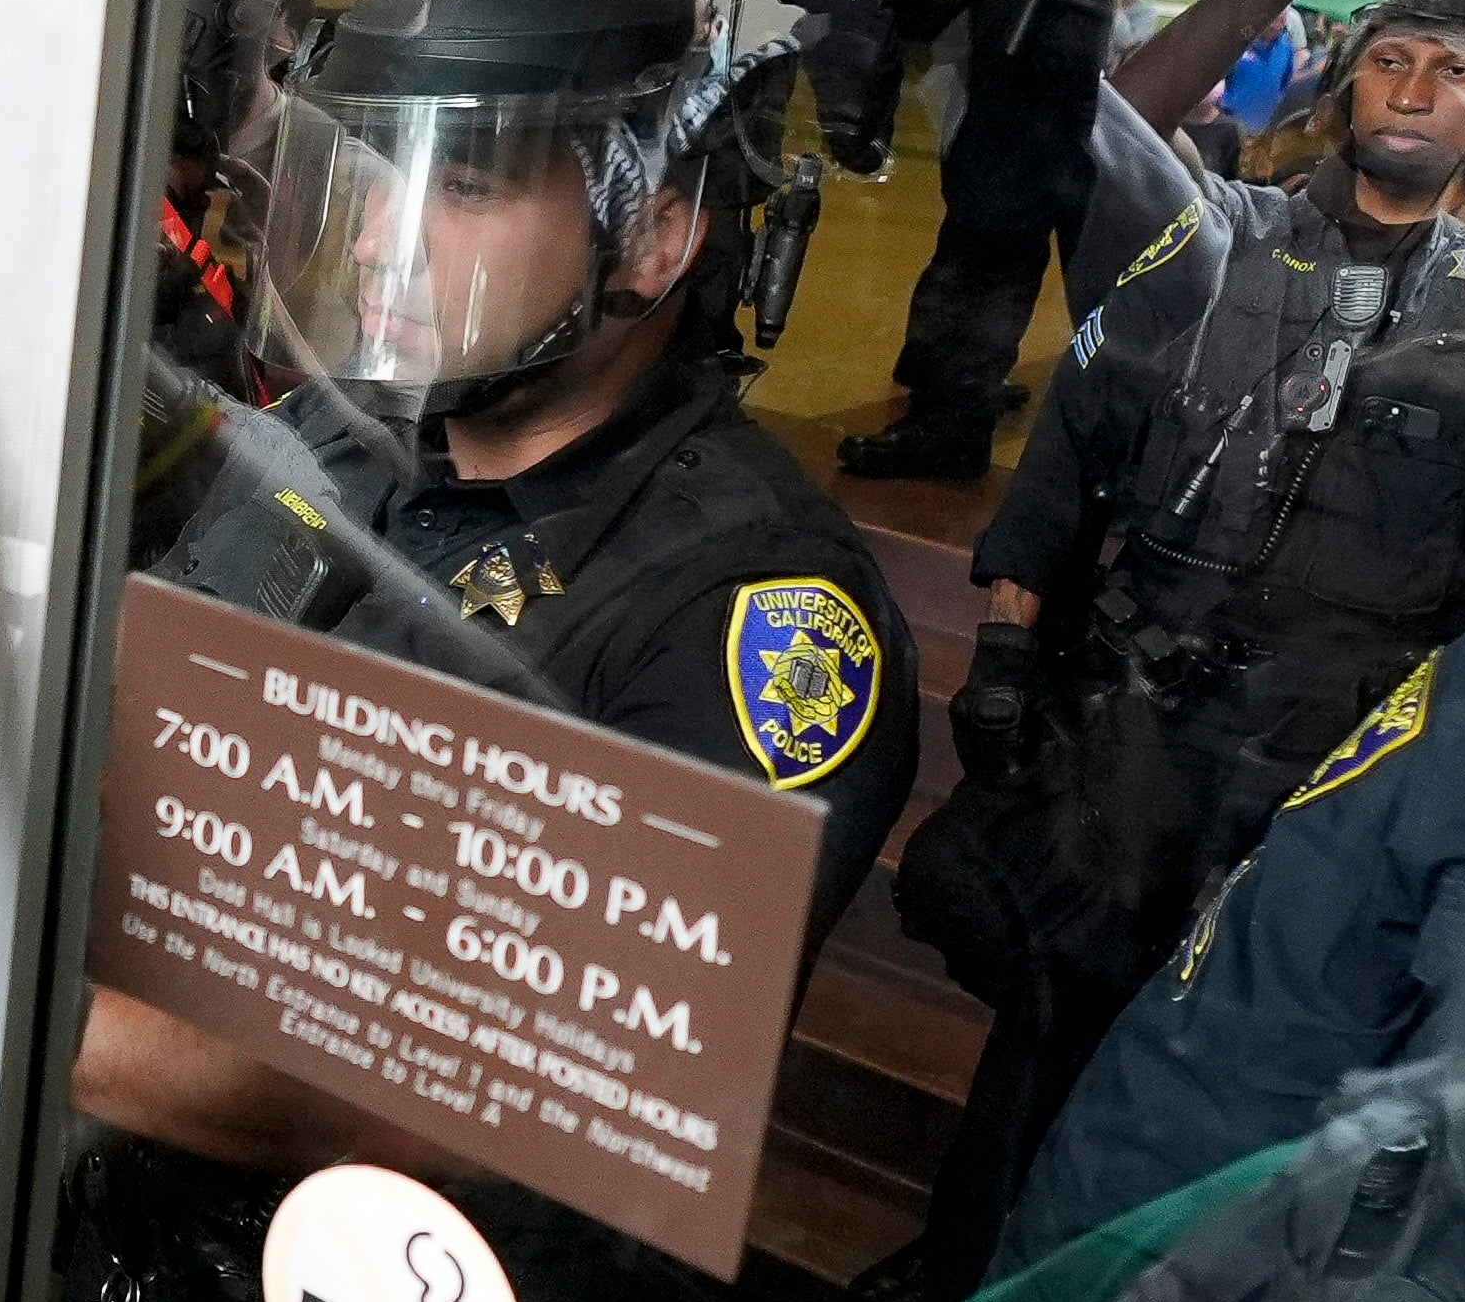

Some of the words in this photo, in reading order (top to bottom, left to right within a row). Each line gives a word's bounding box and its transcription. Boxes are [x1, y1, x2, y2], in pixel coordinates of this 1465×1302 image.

[752, 591, 859, 636] UNIVERSITY
[856, 634, 876, 658] OF
[766, 610, 864, 667] CALIFORNIA
[263, 667, 454, 767] BUILDING
[462, 736, 625, 829] HOURS
[758, 718, 823, 764] POLICE
[153, 707, 251, 781] 7:00
[263, 748, 378, 828] A.M.
[444, 817, 590, 912] 10:00
[604, 875, 738, 967] P.M.
[465, 787, 545, 842] Friday
[154, 793, 252, 869] 9:00
[264, 837, 379, 920] A.M.
[444, 910, 565, 998] 6:00
[578, 963, 709, 1056] P.M.
[129, 873, 168, 910] THIS
[170, 890, 267, 953] ENTRANCE
[268, 933, 310, 972] HAS
[311, 951, 349, 989] NO
[350, 968, 390, 1007] KEY
[391, 986, 469, 1042] ACCESS
[470, 1021, 536, 1071] AFTER
[536, 1049, 629, 1113] POSTED
[629, 1089, 719, 1152] HOURS
[266, 972, 360, 1035] Entrance
[399, 1033, 459, 1080] Level
[489, 1074, 532, 1113] and
[280, 1006, 375, 1070] Entrance
[415, 1068, 476, 1116] Level
[482, 1098, 501, 1127] A
[409, 957, 525, 1032] University
[533, 1010, 635, 1078] Holidays
